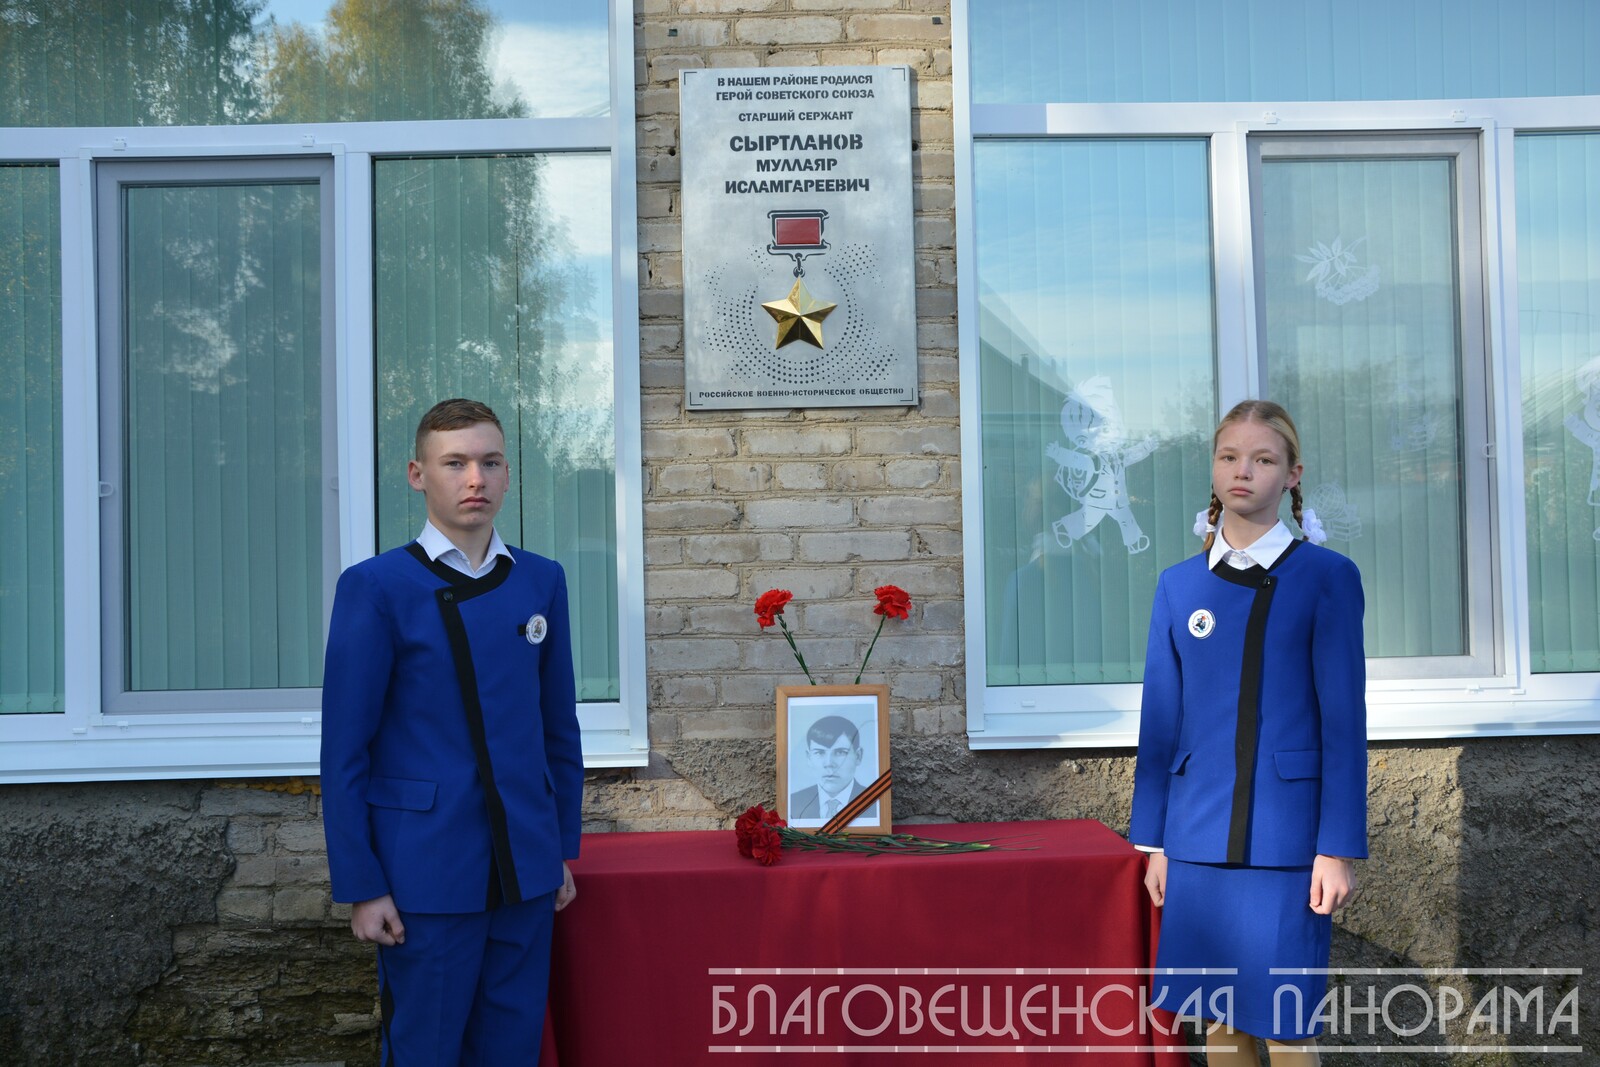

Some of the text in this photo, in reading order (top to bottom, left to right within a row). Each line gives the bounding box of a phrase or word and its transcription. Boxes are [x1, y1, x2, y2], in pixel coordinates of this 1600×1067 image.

[717, 74, 873, 87] В НАШЕМ РАЙОНЕ РОДИЛСЯ
[716, 89, 875, 101] ГЕРОЙ СОВЕТСКОГО СОЮЗА
[738, 109, 854, 122] СТАРШИЙ СЕРЖАНТ
[729, 134, 863, 152] СЫРТЛАНОВ
[756, 158, 838, 172] МУЛЛАЯР
[725, 178, 870, 194] ИСЛАМГАРЕЕВИЧ
[699, 387, 904, 399] РОССИЙСКОЕ ВОЕННО-ИСТОРИЧЕСКОЕ ОБЩЕСТВО
